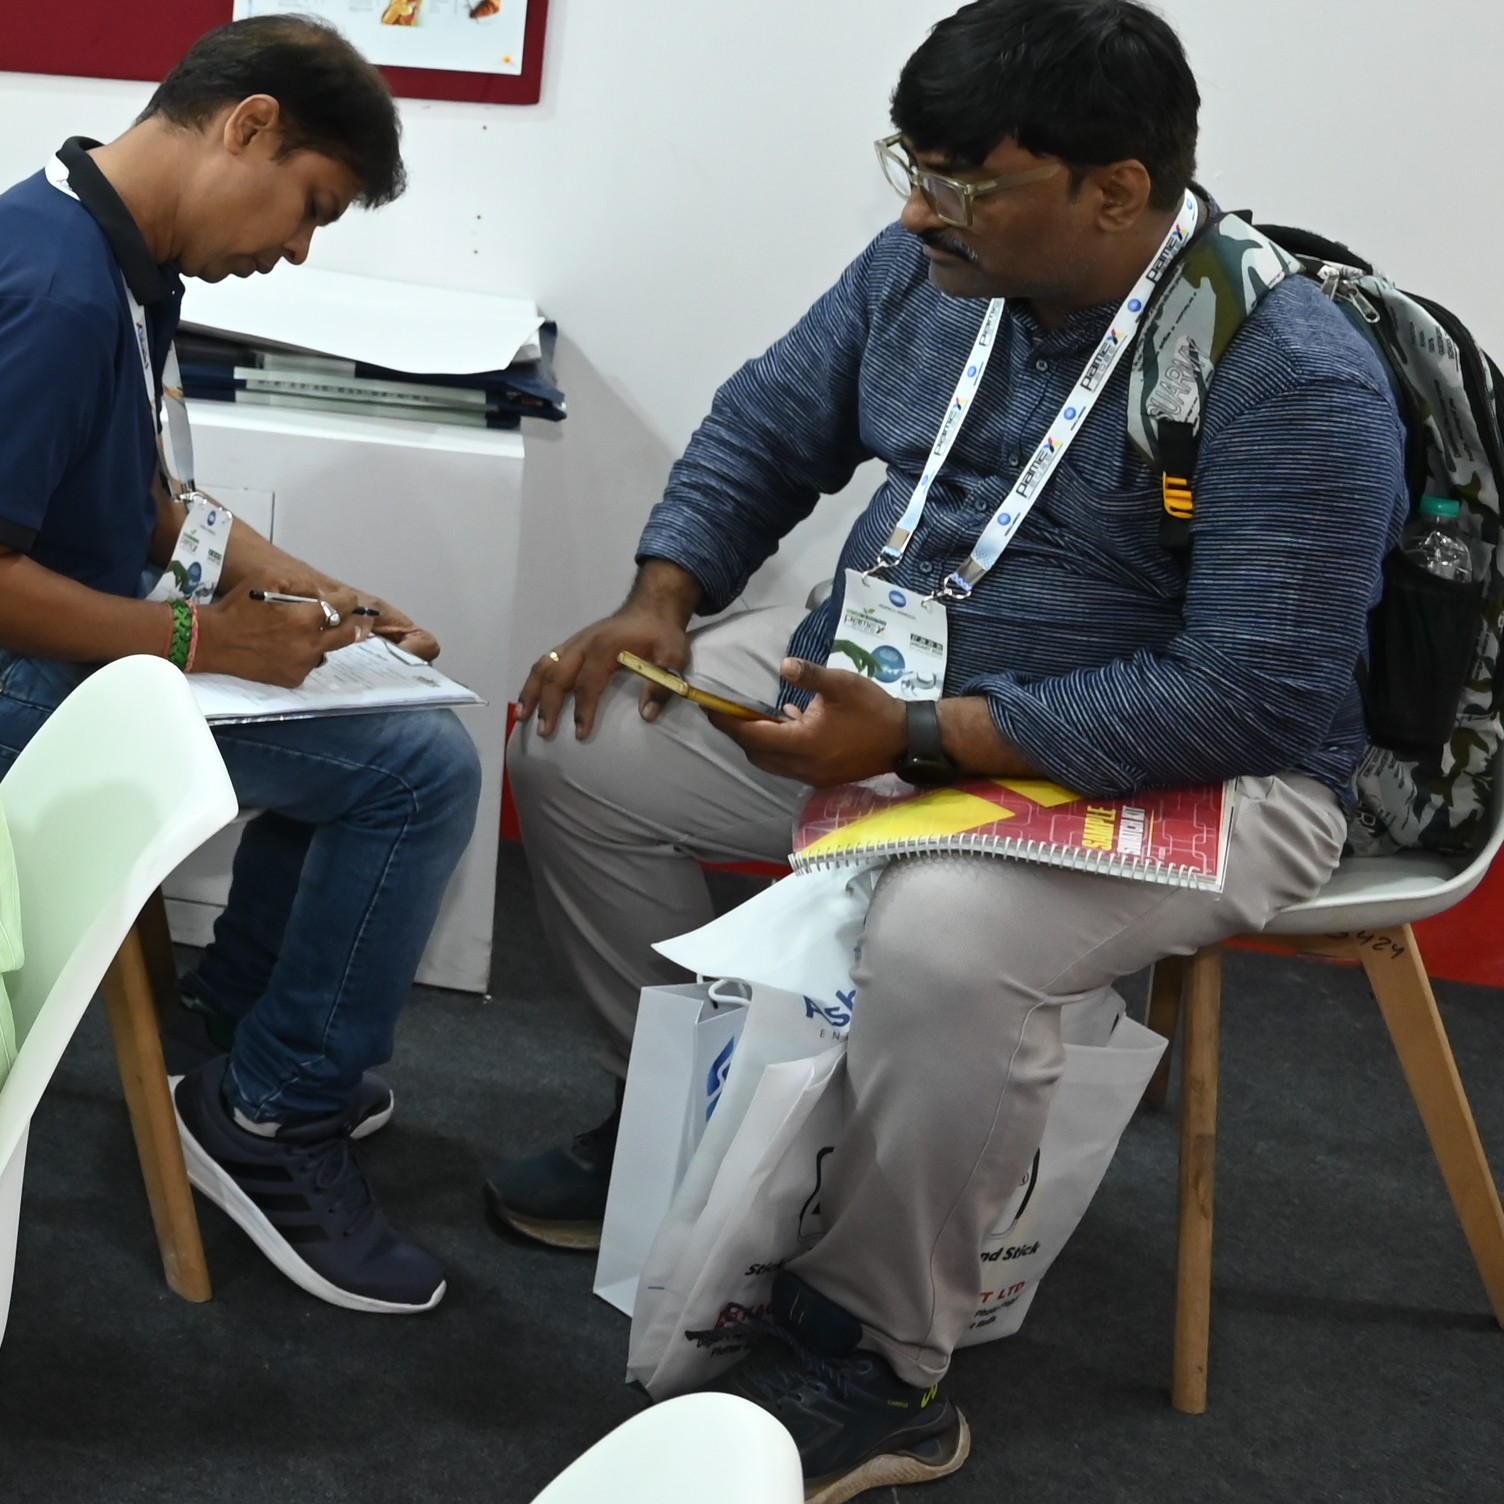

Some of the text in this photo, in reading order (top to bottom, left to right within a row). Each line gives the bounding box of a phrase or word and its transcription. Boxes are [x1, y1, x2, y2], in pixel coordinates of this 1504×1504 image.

[1082, 805, 1116, 851] SAMPLE
[1117, 818, 1144, 855] SWATCH
[981, 1240, 1040, 1262] nd Stick
[997, 1281, 1025, 1300] LTD
